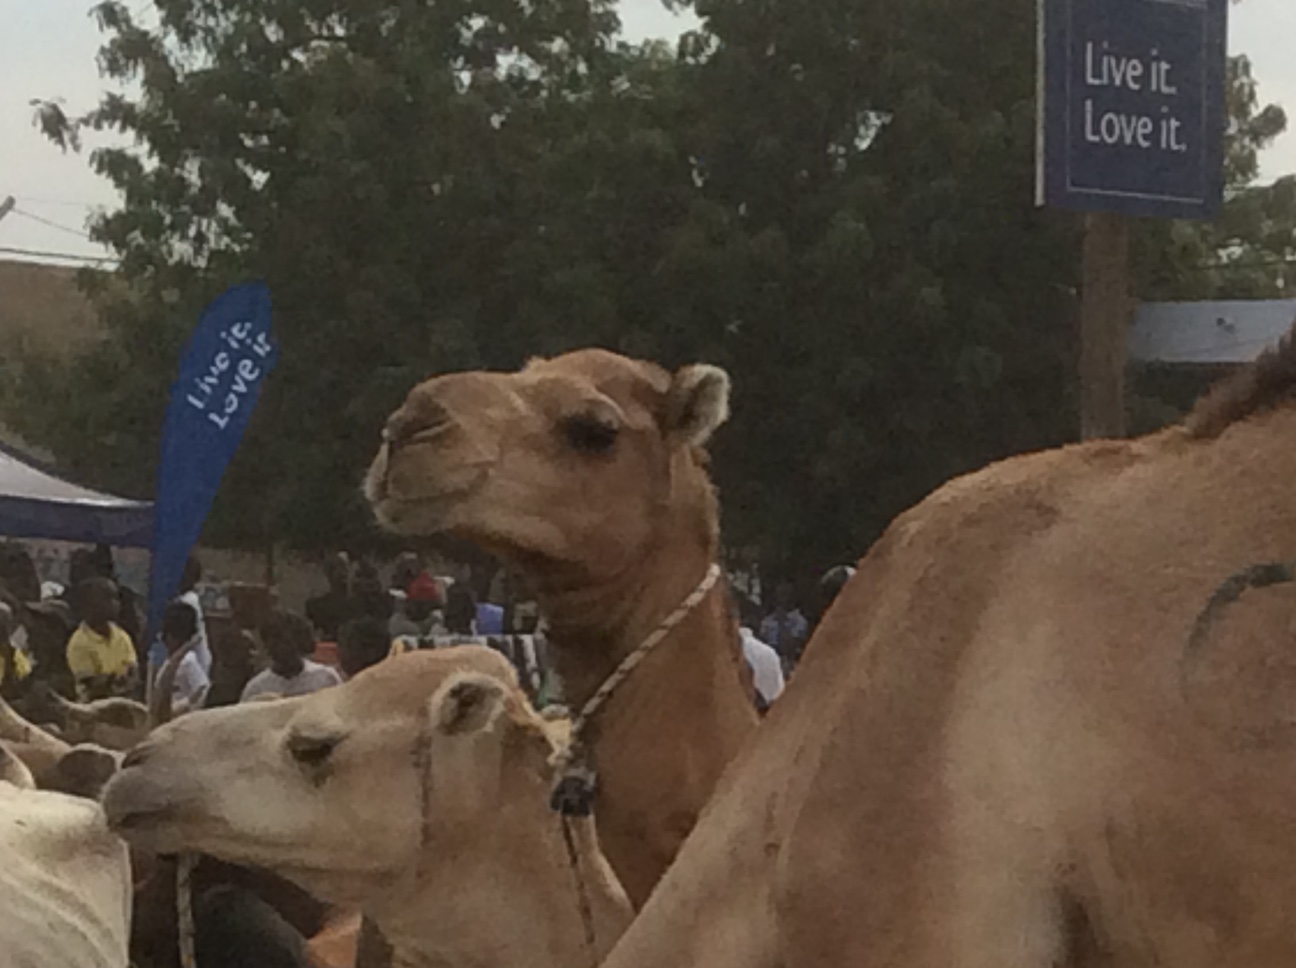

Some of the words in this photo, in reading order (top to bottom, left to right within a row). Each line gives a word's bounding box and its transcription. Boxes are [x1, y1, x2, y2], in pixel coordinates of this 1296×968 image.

[1086, 40, 1143, 90] Live
[1084, 98, 1153, 149] Love
[1160, 105, 1187, 152] it.
[187, 352, 231, 410] Live
[208, 358, 261, 430] Love
